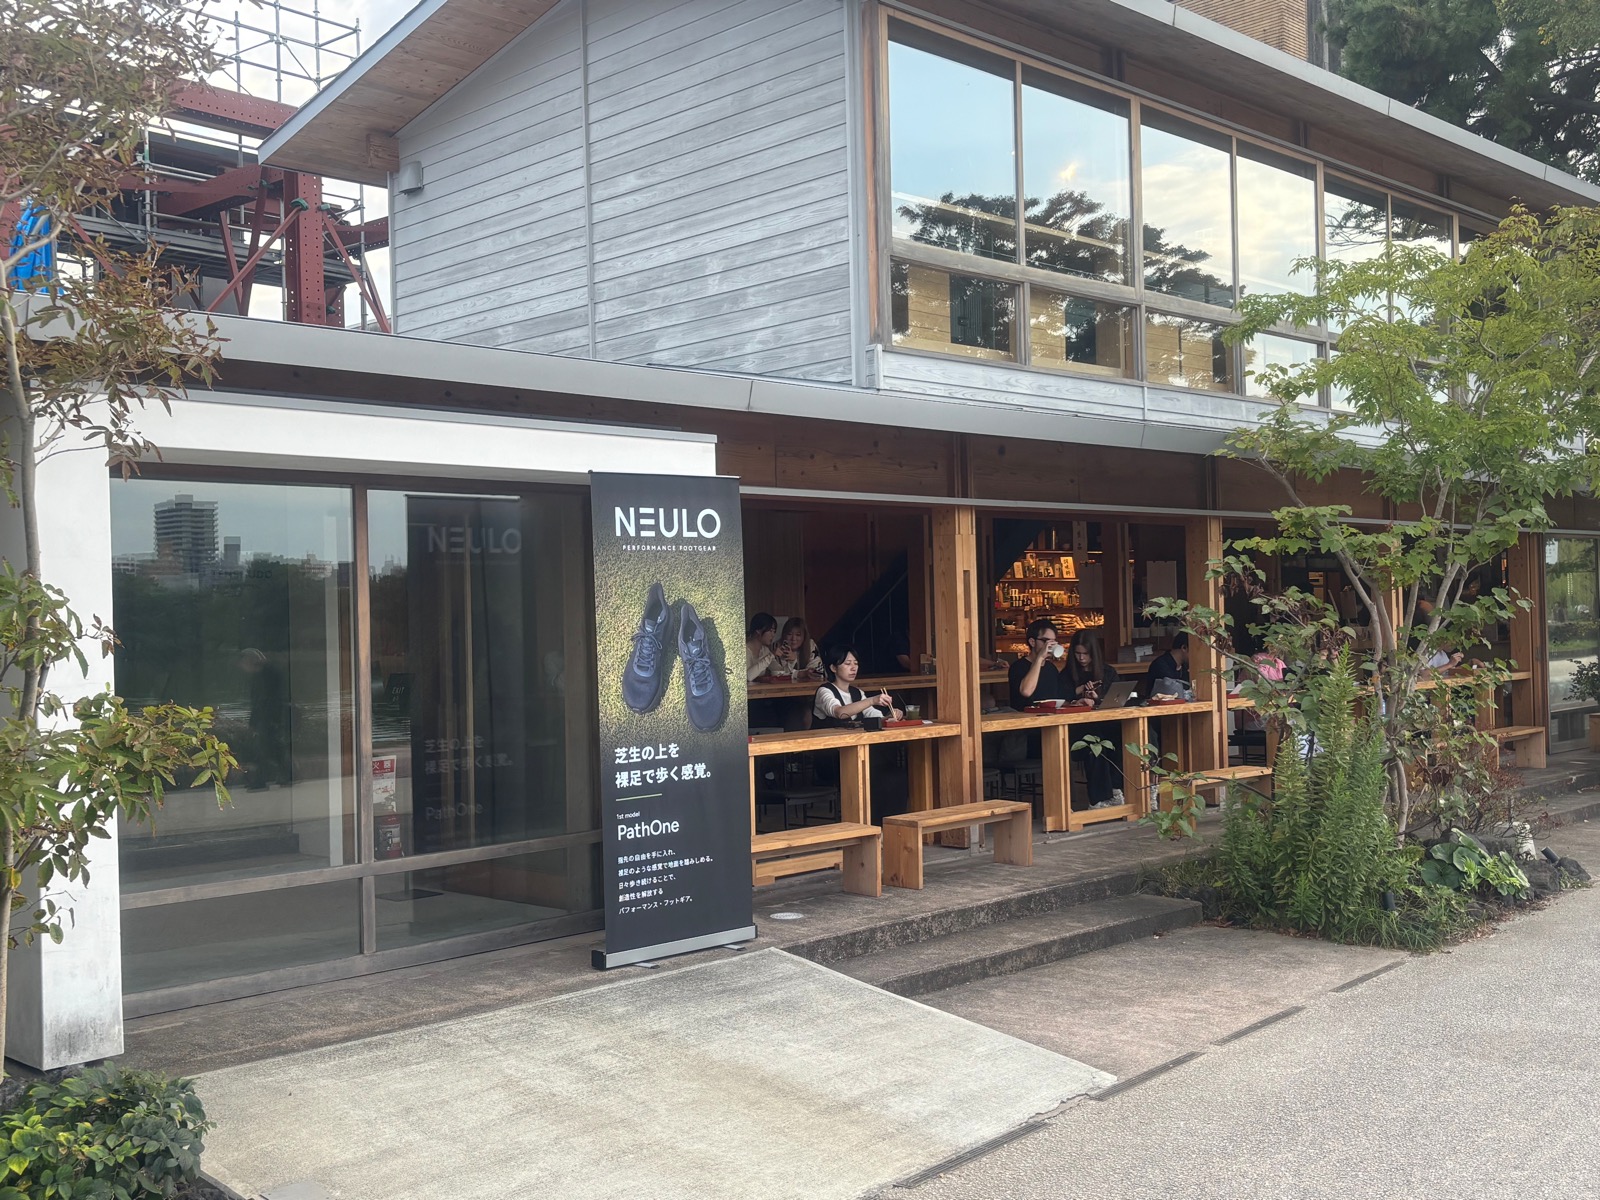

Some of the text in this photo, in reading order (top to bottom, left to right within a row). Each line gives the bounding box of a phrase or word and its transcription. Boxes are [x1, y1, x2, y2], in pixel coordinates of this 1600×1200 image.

[614, 506, 721, 539] NEULO
[614, 743, 680, 765] 芝生の上を
[615, 763, 711, 789] 裸足で歩く感覚。
[625, 811, 641, 819] model
[617, 819, 680, 841] PathOne
